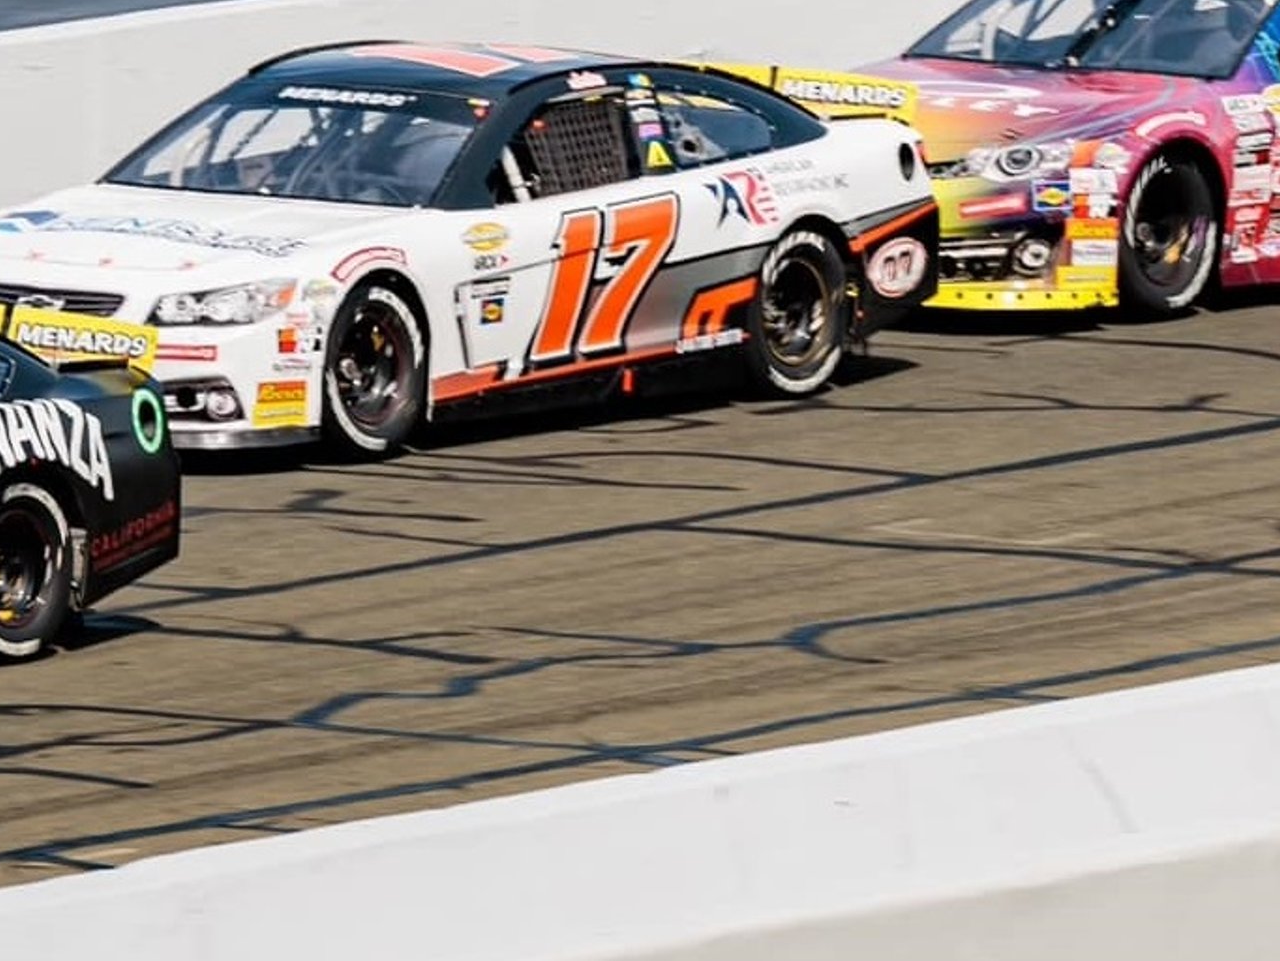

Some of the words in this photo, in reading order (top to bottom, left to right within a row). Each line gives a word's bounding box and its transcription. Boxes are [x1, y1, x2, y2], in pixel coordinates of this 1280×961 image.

[279, 86, 406, 107] MENARDS
[782, 79, 905, 108] MENARDS
[531, 191, 680, 362] 17
[19, 322, 147, 357] MENARDS
